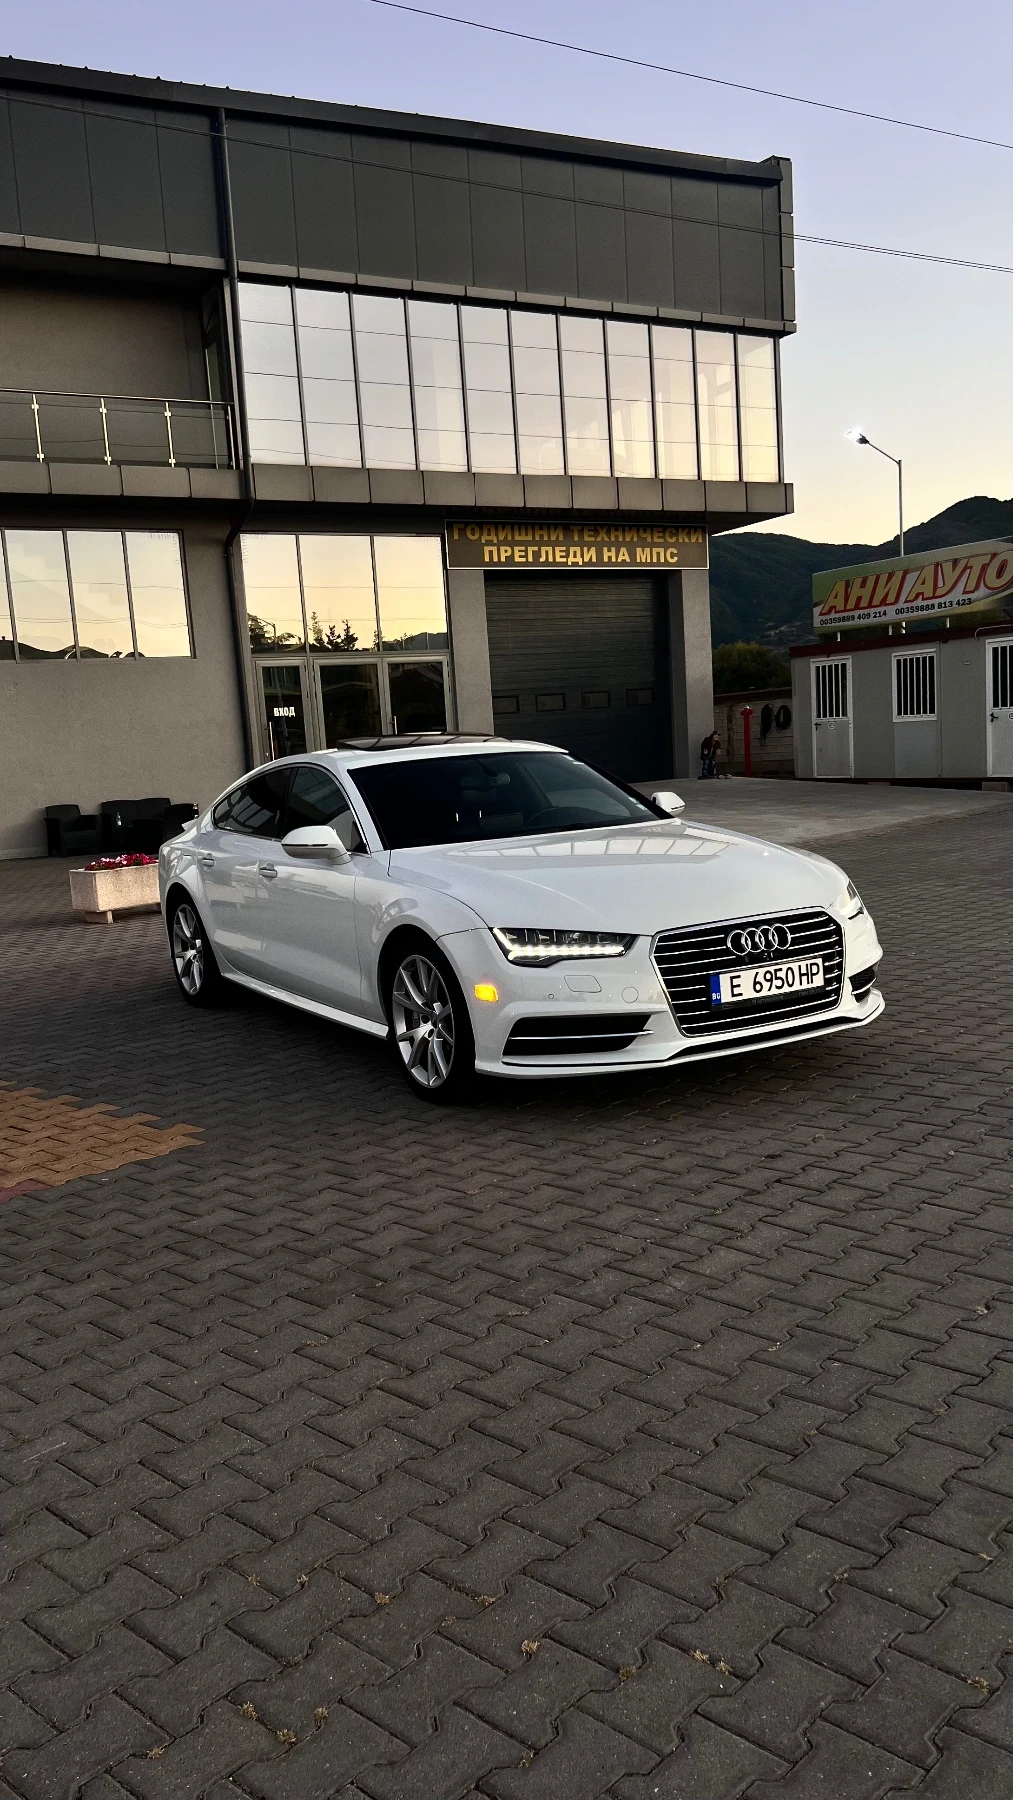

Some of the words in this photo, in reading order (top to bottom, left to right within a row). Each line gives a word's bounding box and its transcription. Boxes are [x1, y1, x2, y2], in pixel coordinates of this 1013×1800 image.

[453, 523, 564, 543] ГОДИШНИ
[570, 525, 703, 543] ТЕХНИЧЕСКИ
[483, 546, 597, 566] ПРЕГЛЕДИ
[603, 547, 630, 563] НА
[636, 547, 679, 563] МПС
[820, 570, 906, 615] АНИ
[904, 550, 1013, 603] АУТО
[857, 612, 872, 621] 409
[872, 609, 888, 619] 214
[937, 601, 954, 611] 813
[955, 598, 973, 607] 423
[274, 707, 295, 717] ВХОД
[730, 975, 743, 998] E
[752, 966, 796, 994] 6950
[798, 962, 820, 987] HP
[712, 992, 721, 1000] BG
